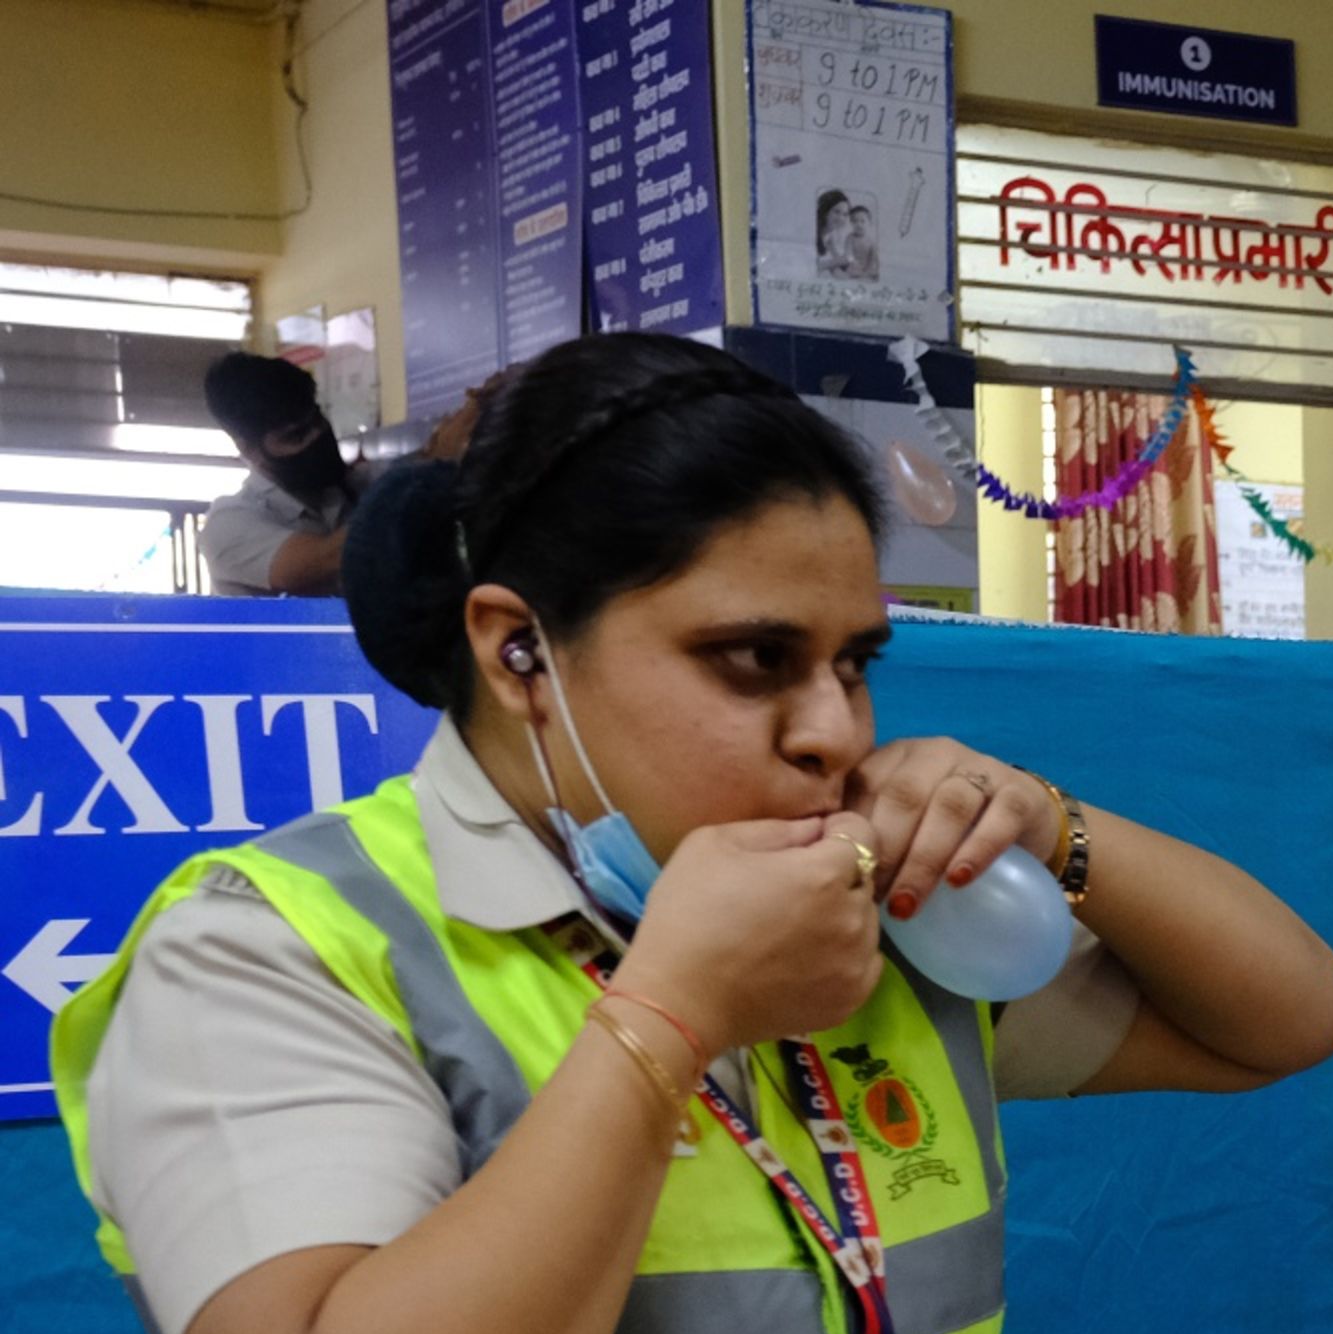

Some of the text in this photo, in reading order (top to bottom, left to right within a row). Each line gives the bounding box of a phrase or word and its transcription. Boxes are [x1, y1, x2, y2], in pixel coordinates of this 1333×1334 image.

[818, 51, 835, 86] 9
[850, 59, 878, 91] to
[904, 67, 938, 102] PM
[1118, 71, 1275, 110] IMMUNISATION
[813, 92, 831, 129] 9
[843, 100, 868, 130] to
[896, 108, 930, 143] PM
[0, 694, 379, 836] EXIT
